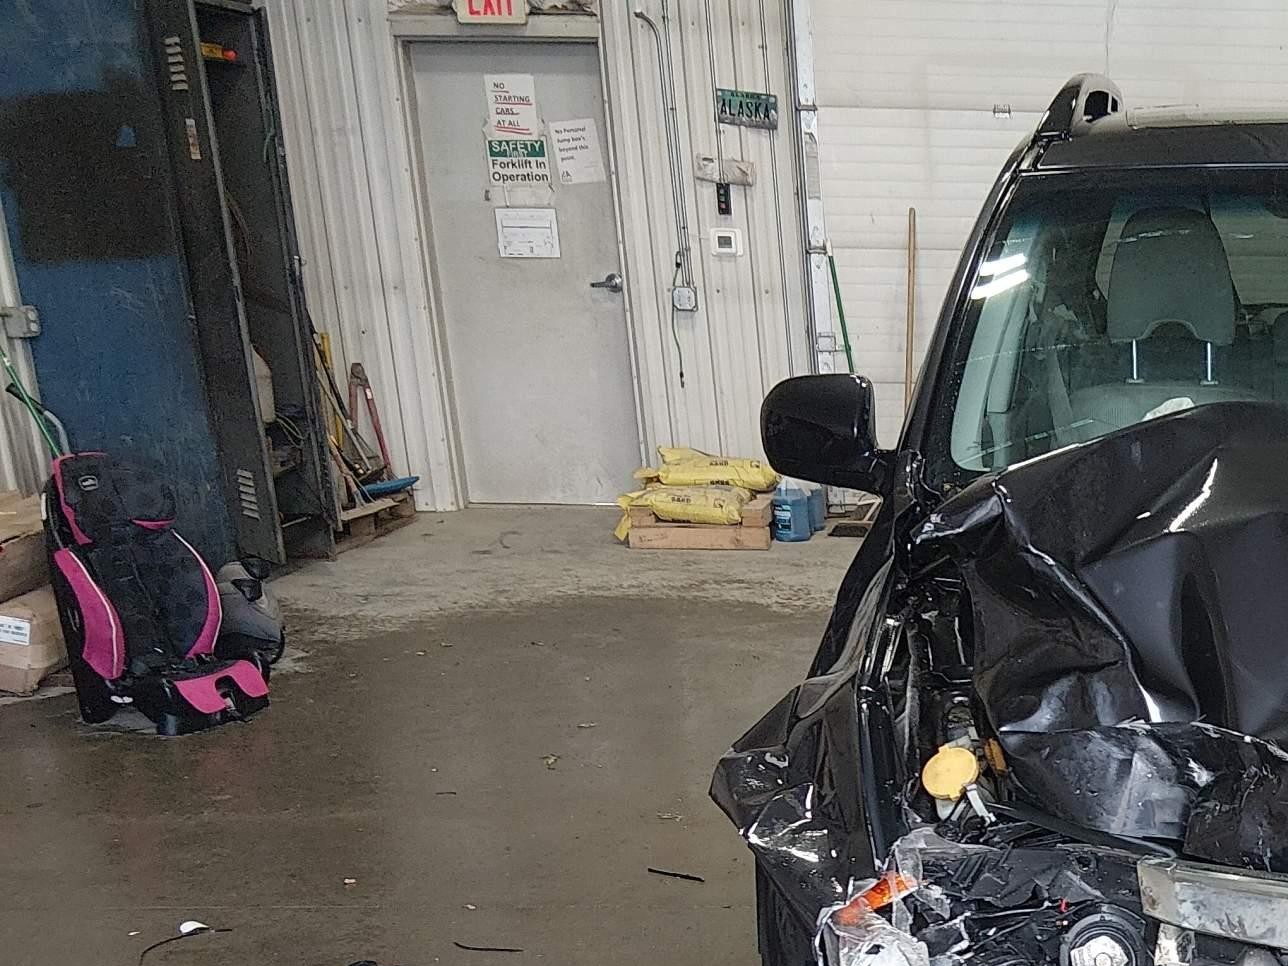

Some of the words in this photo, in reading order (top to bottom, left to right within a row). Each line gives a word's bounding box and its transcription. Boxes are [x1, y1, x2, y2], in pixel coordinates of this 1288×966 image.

[720, 98, 770, 120] ALASKA
[508, 119, 520, 127] ALL
[492, 141, 541, 152] SAFETY
[492, 159, 532, 169] Forklift
[536, 159, 547, 169] In
[492, 171, 549, 184] Operation
